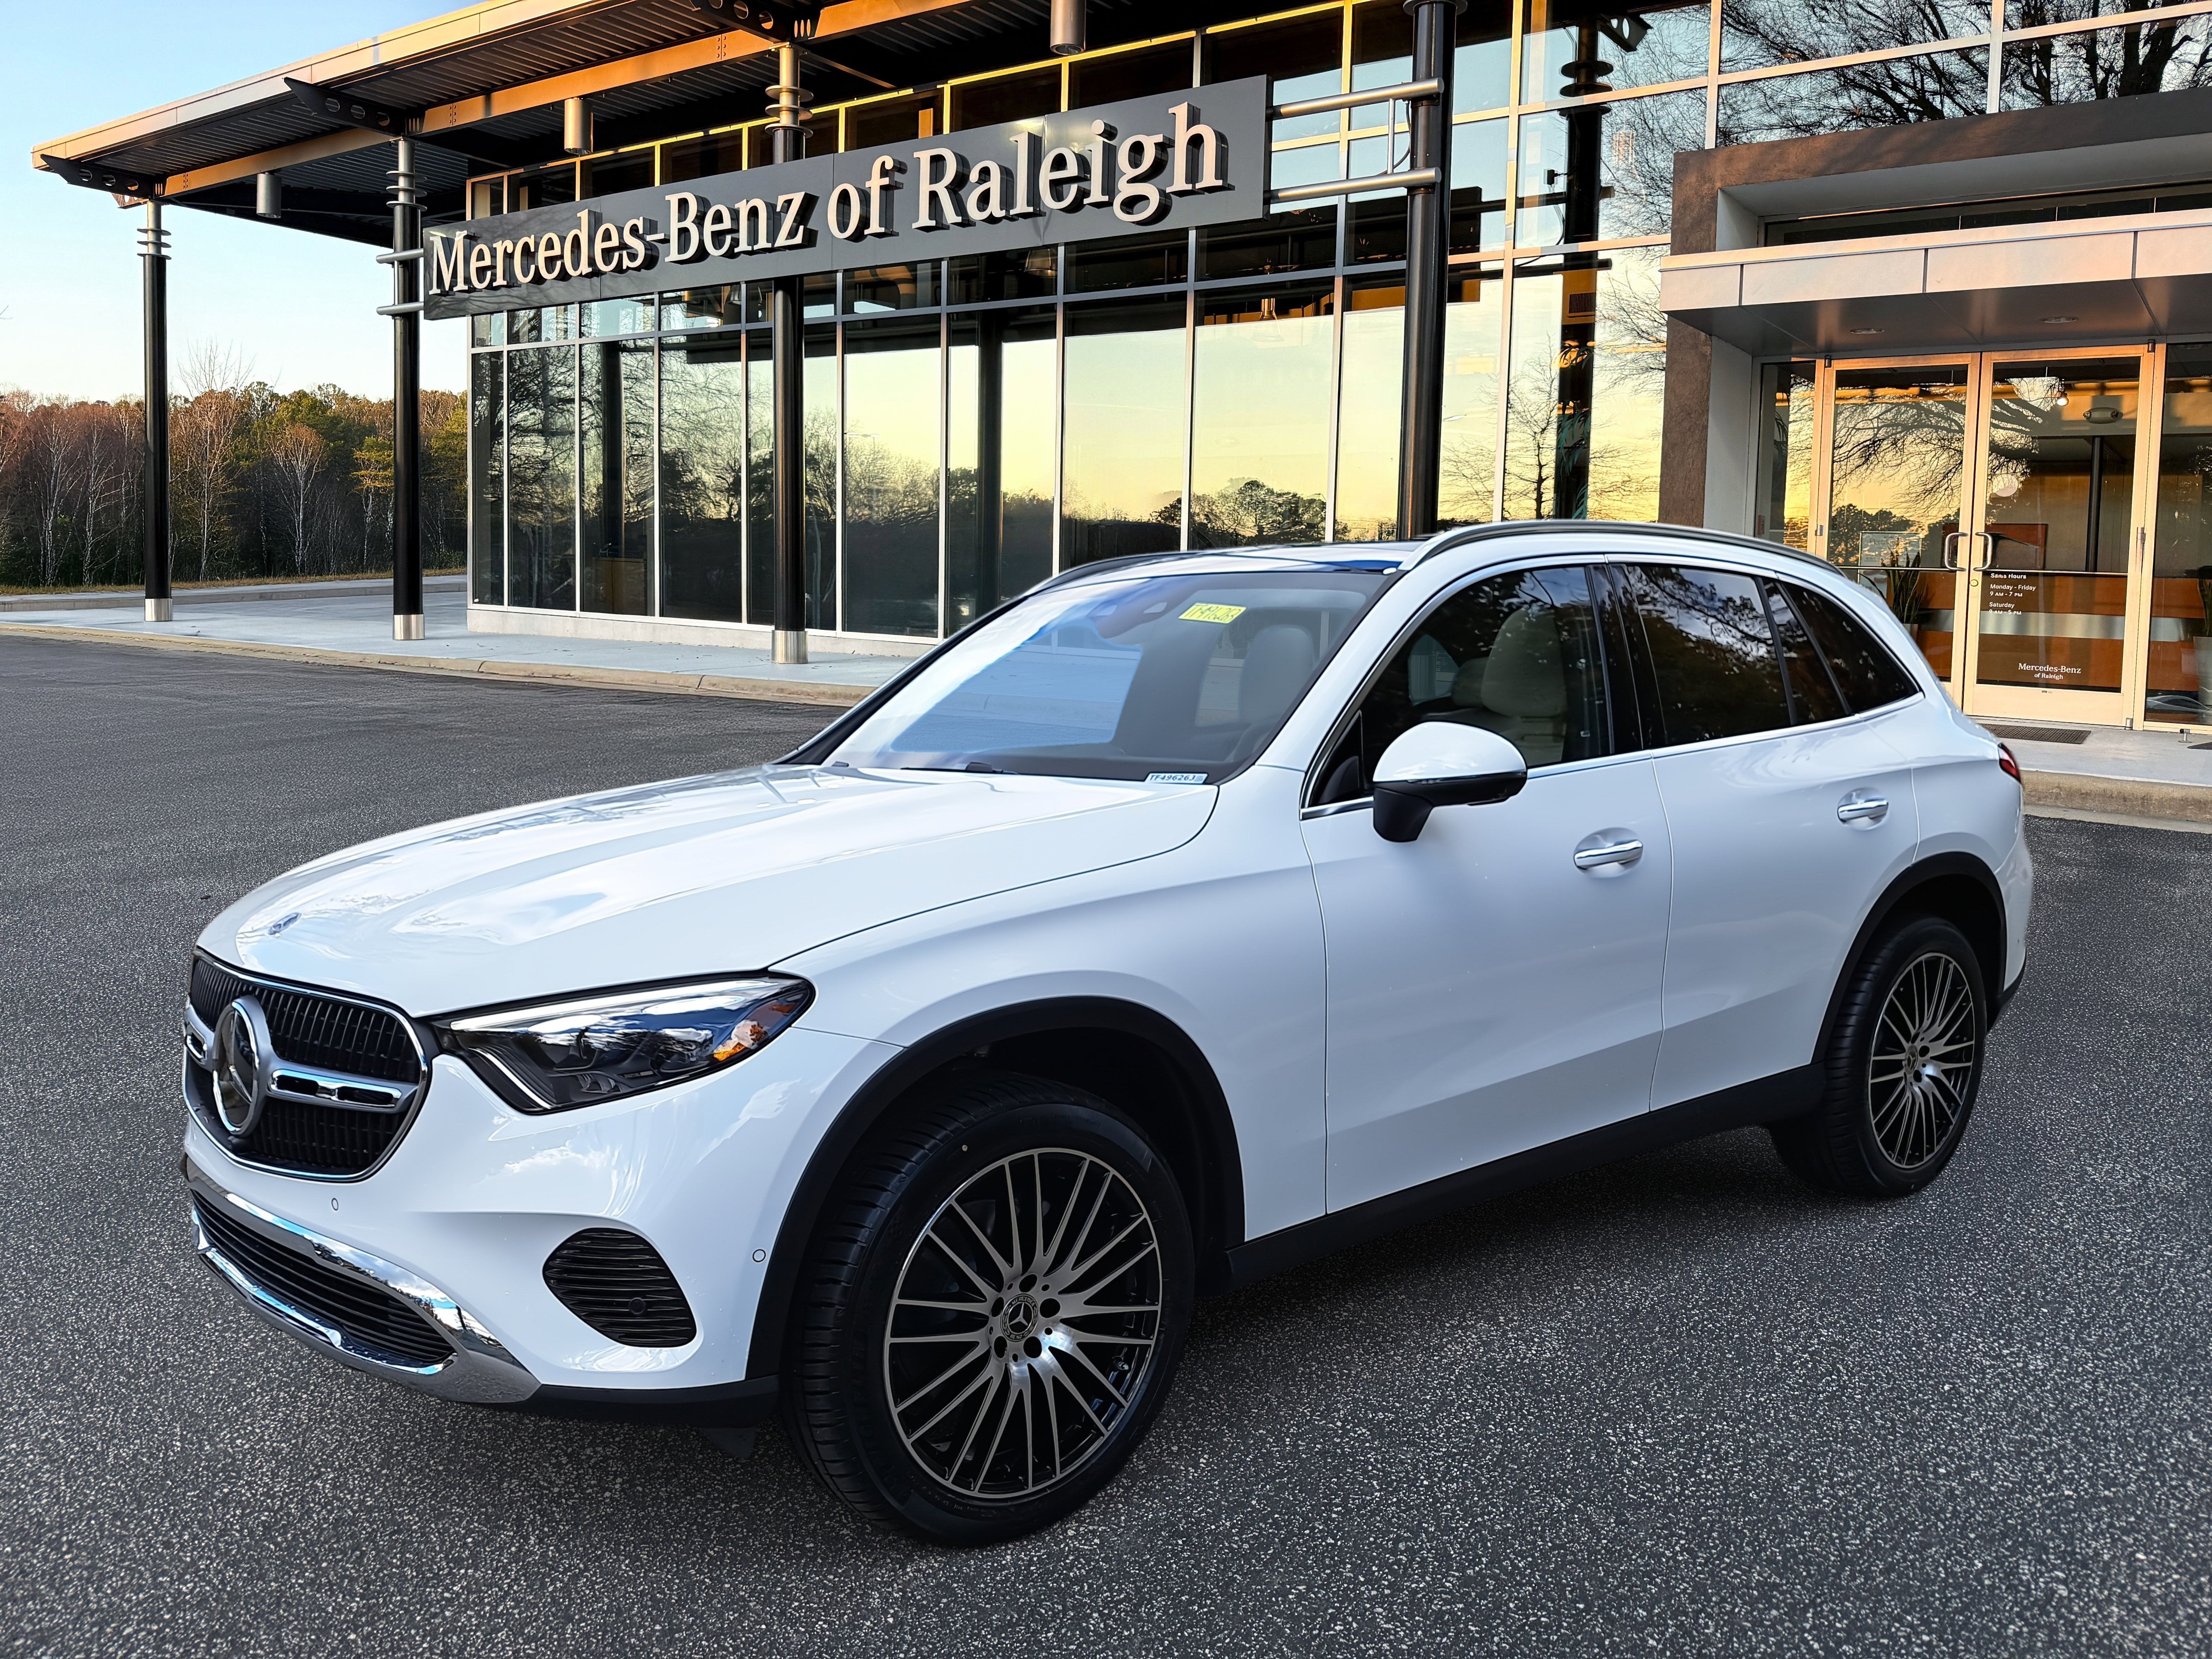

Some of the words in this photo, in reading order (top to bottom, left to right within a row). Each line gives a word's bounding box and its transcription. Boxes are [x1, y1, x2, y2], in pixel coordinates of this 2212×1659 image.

[429, 191, 807, 295] Mercedes-Benz
[827, 155, 894, 239] of
[912, 101, 1223, 223] Raleigh
[2018, 663, 2081, 673] Mercedes-Benz
